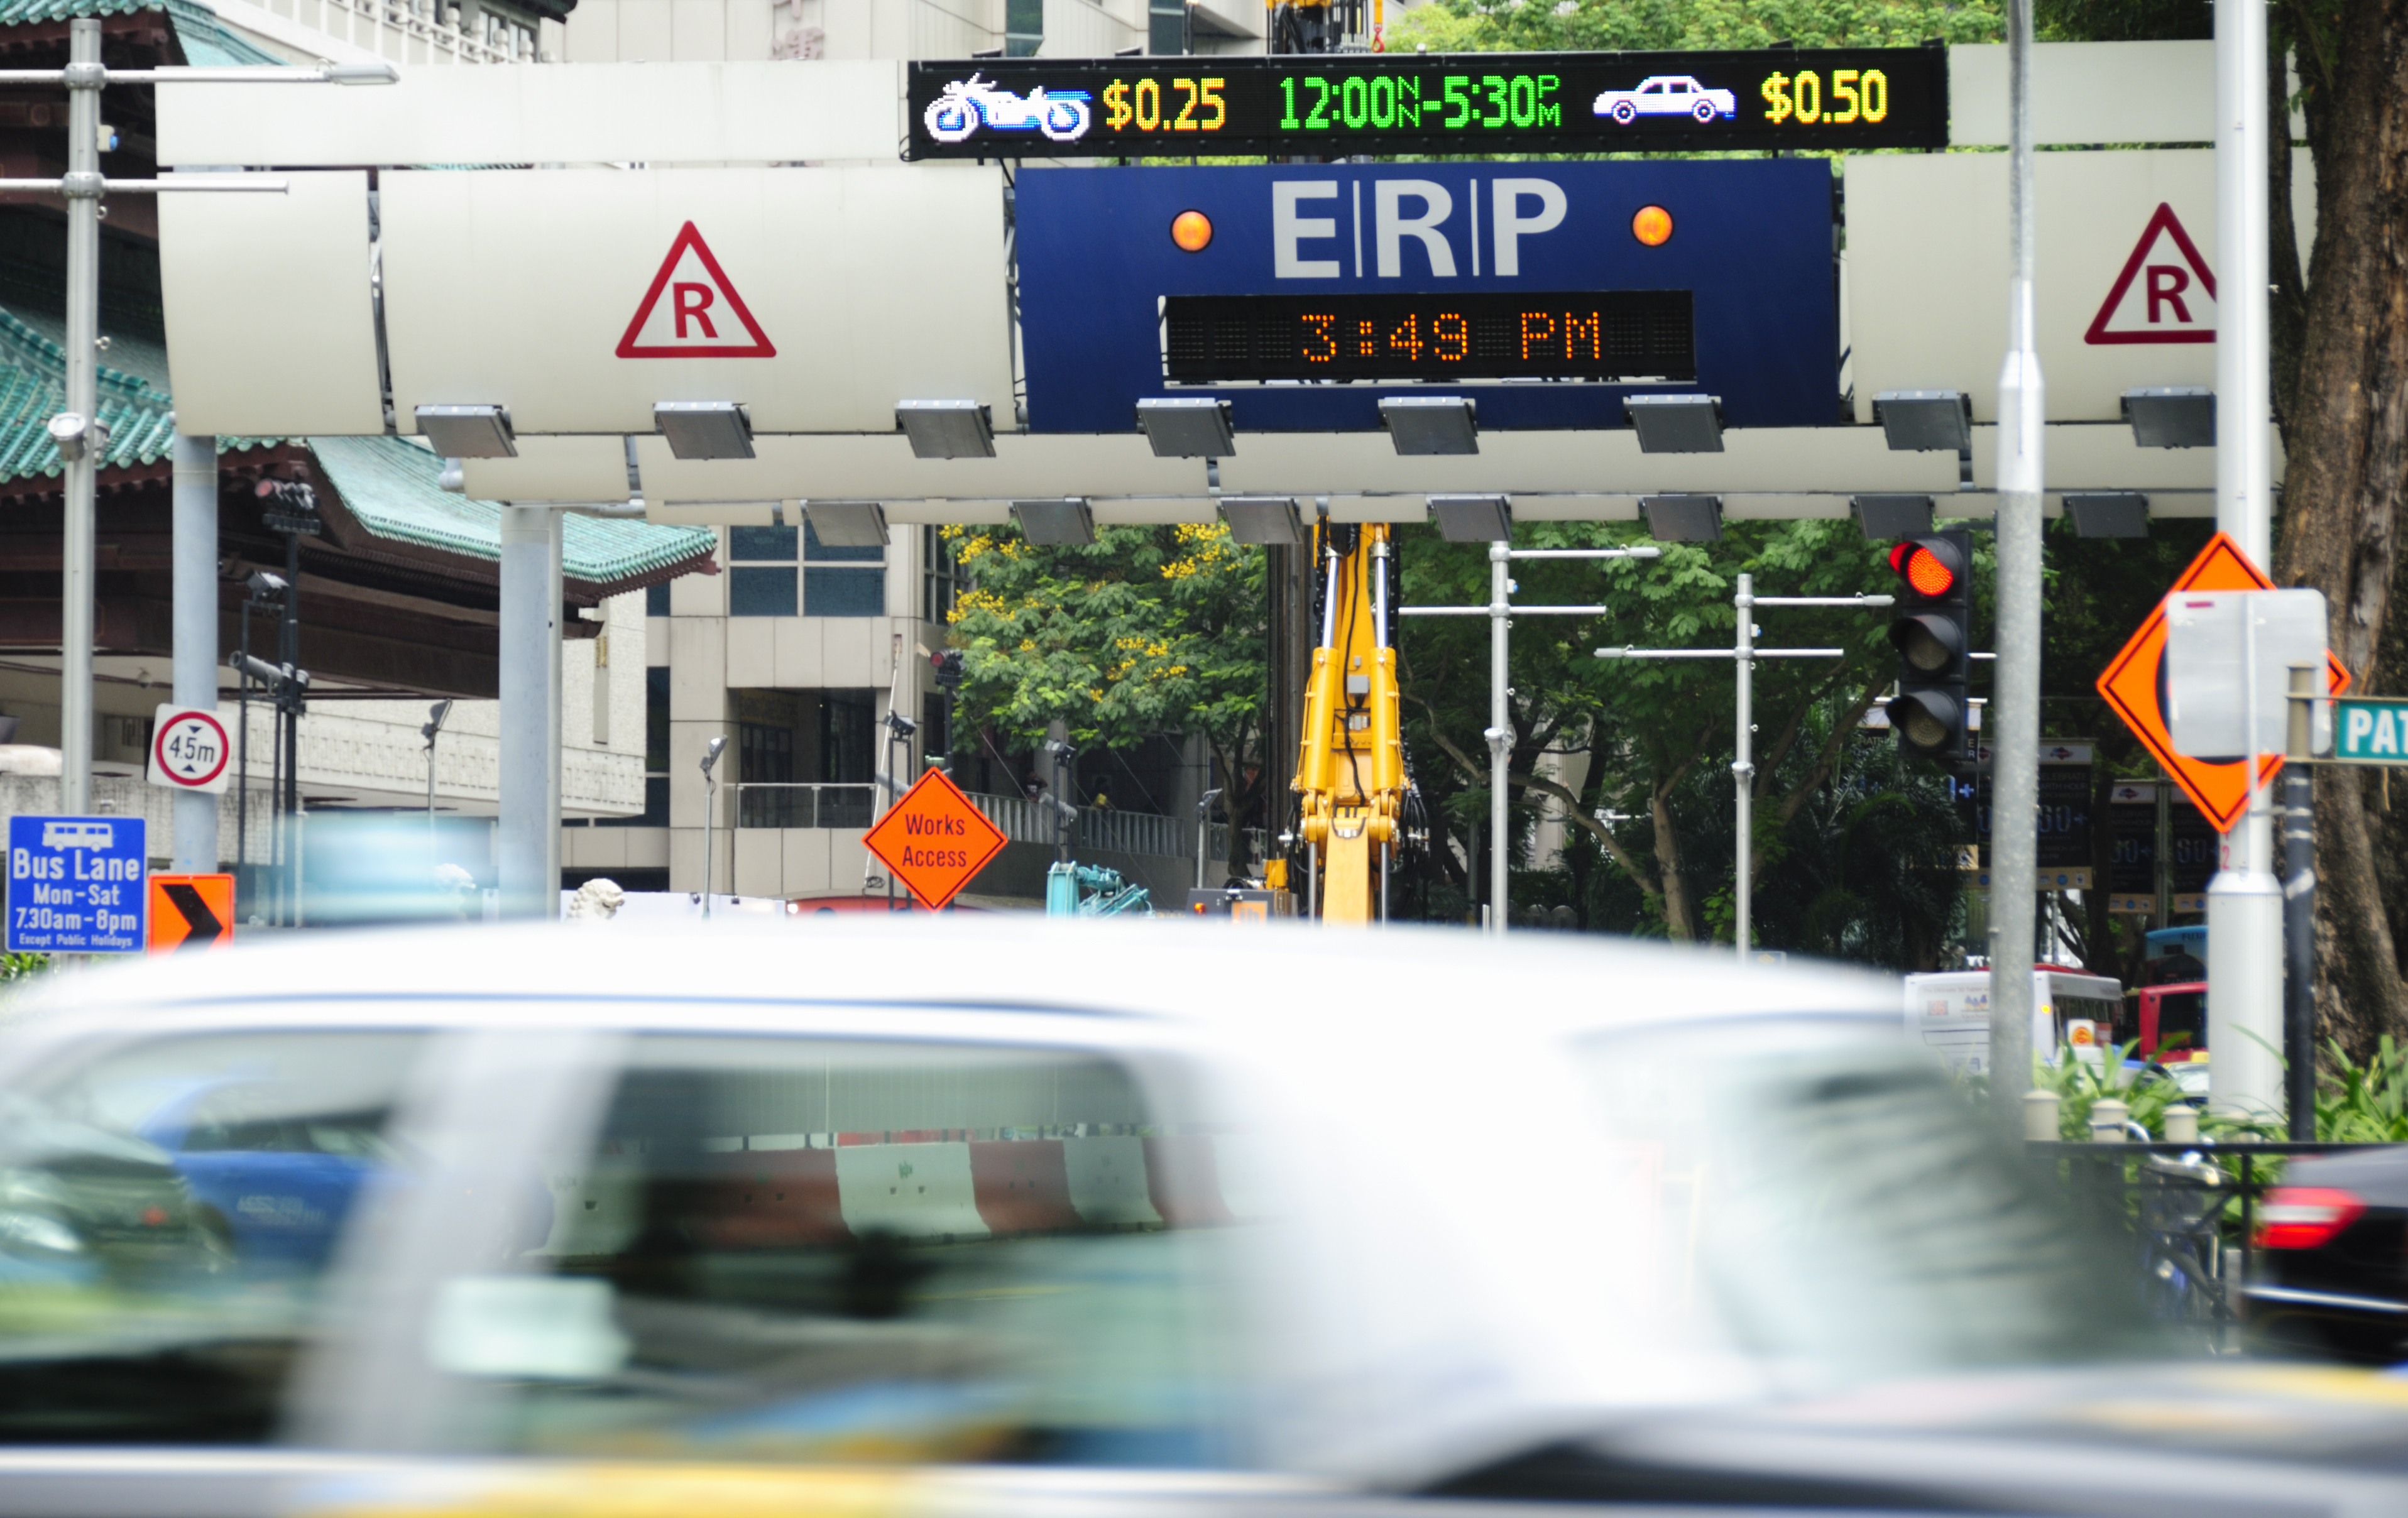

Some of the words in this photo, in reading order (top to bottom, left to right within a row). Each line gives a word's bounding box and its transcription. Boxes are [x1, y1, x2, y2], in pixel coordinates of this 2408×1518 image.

[1102, 77, 1226, 132] $0.25
[1761, 68, 1888, 124] $0.50
[672, 281, 719, 339] R
[2146, 265, 2194, 324] R
[1302, 314, 1468, 362] 3:49
[1521, 312, 1600, 360] PM
[169, 735, 215, 763] 4.5m
[904, 814, 965, 836] Works
[13, 848, 65, 880] Bus
[74, 848, 140, 881] Lane
[902, 845, 967, 868] Access
[19, 932, 52, 947] Except
[56, 934, 86, 946] Public
[90, 934, 133, 949] Holidays
